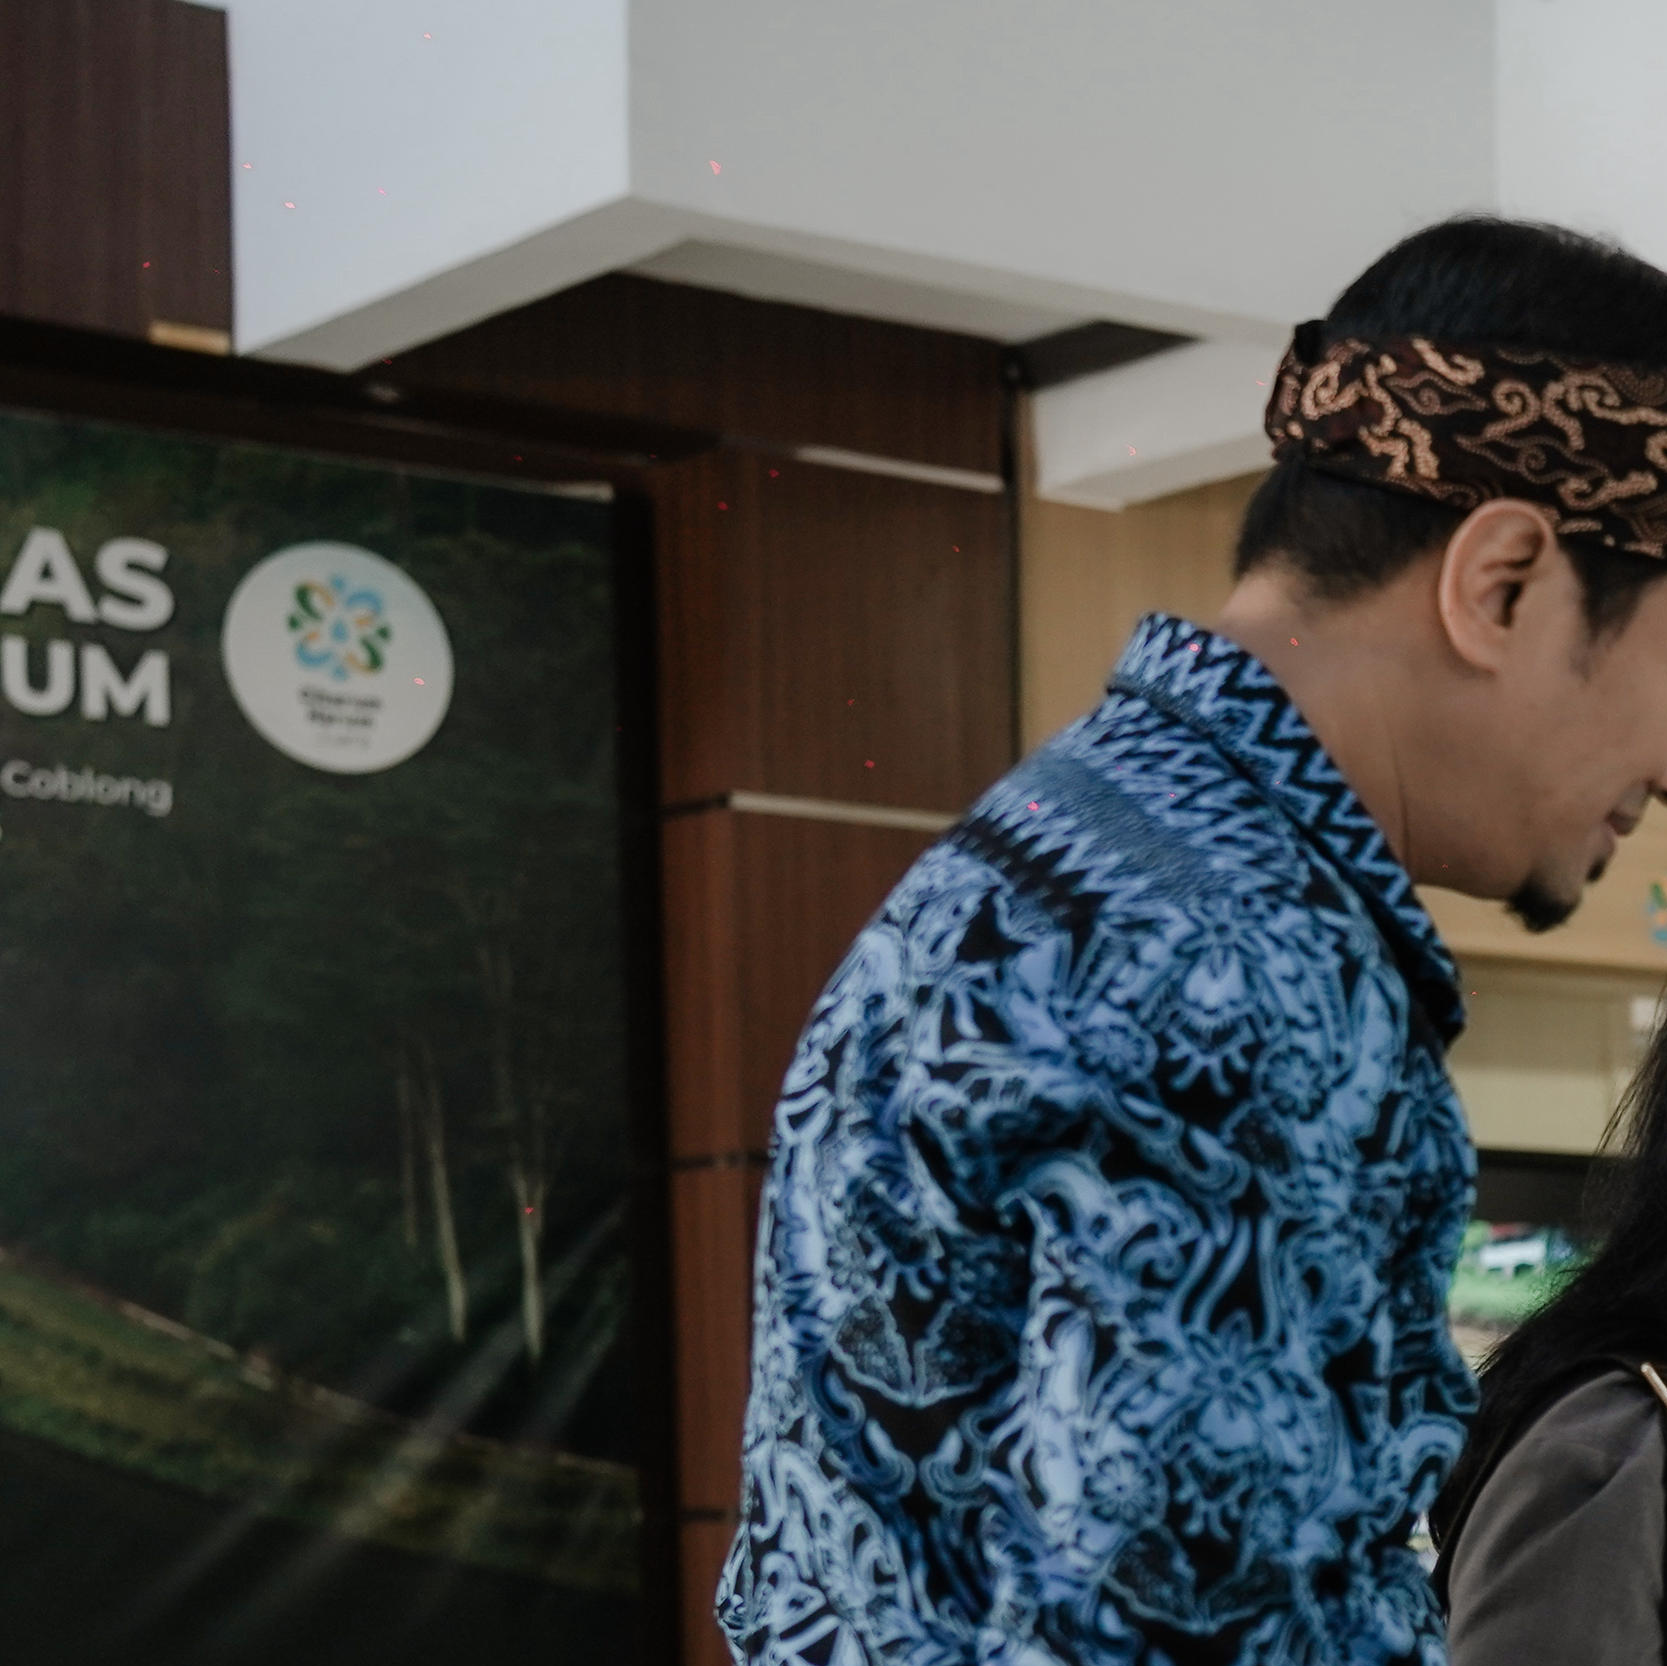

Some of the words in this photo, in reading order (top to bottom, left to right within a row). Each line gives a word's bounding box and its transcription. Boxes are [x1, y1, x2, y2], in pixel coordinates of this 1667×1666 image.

[0, 526, 175, 631] AS
[3, 634, 171, 728] UM
[1, 759, 173, 815] Coblong
